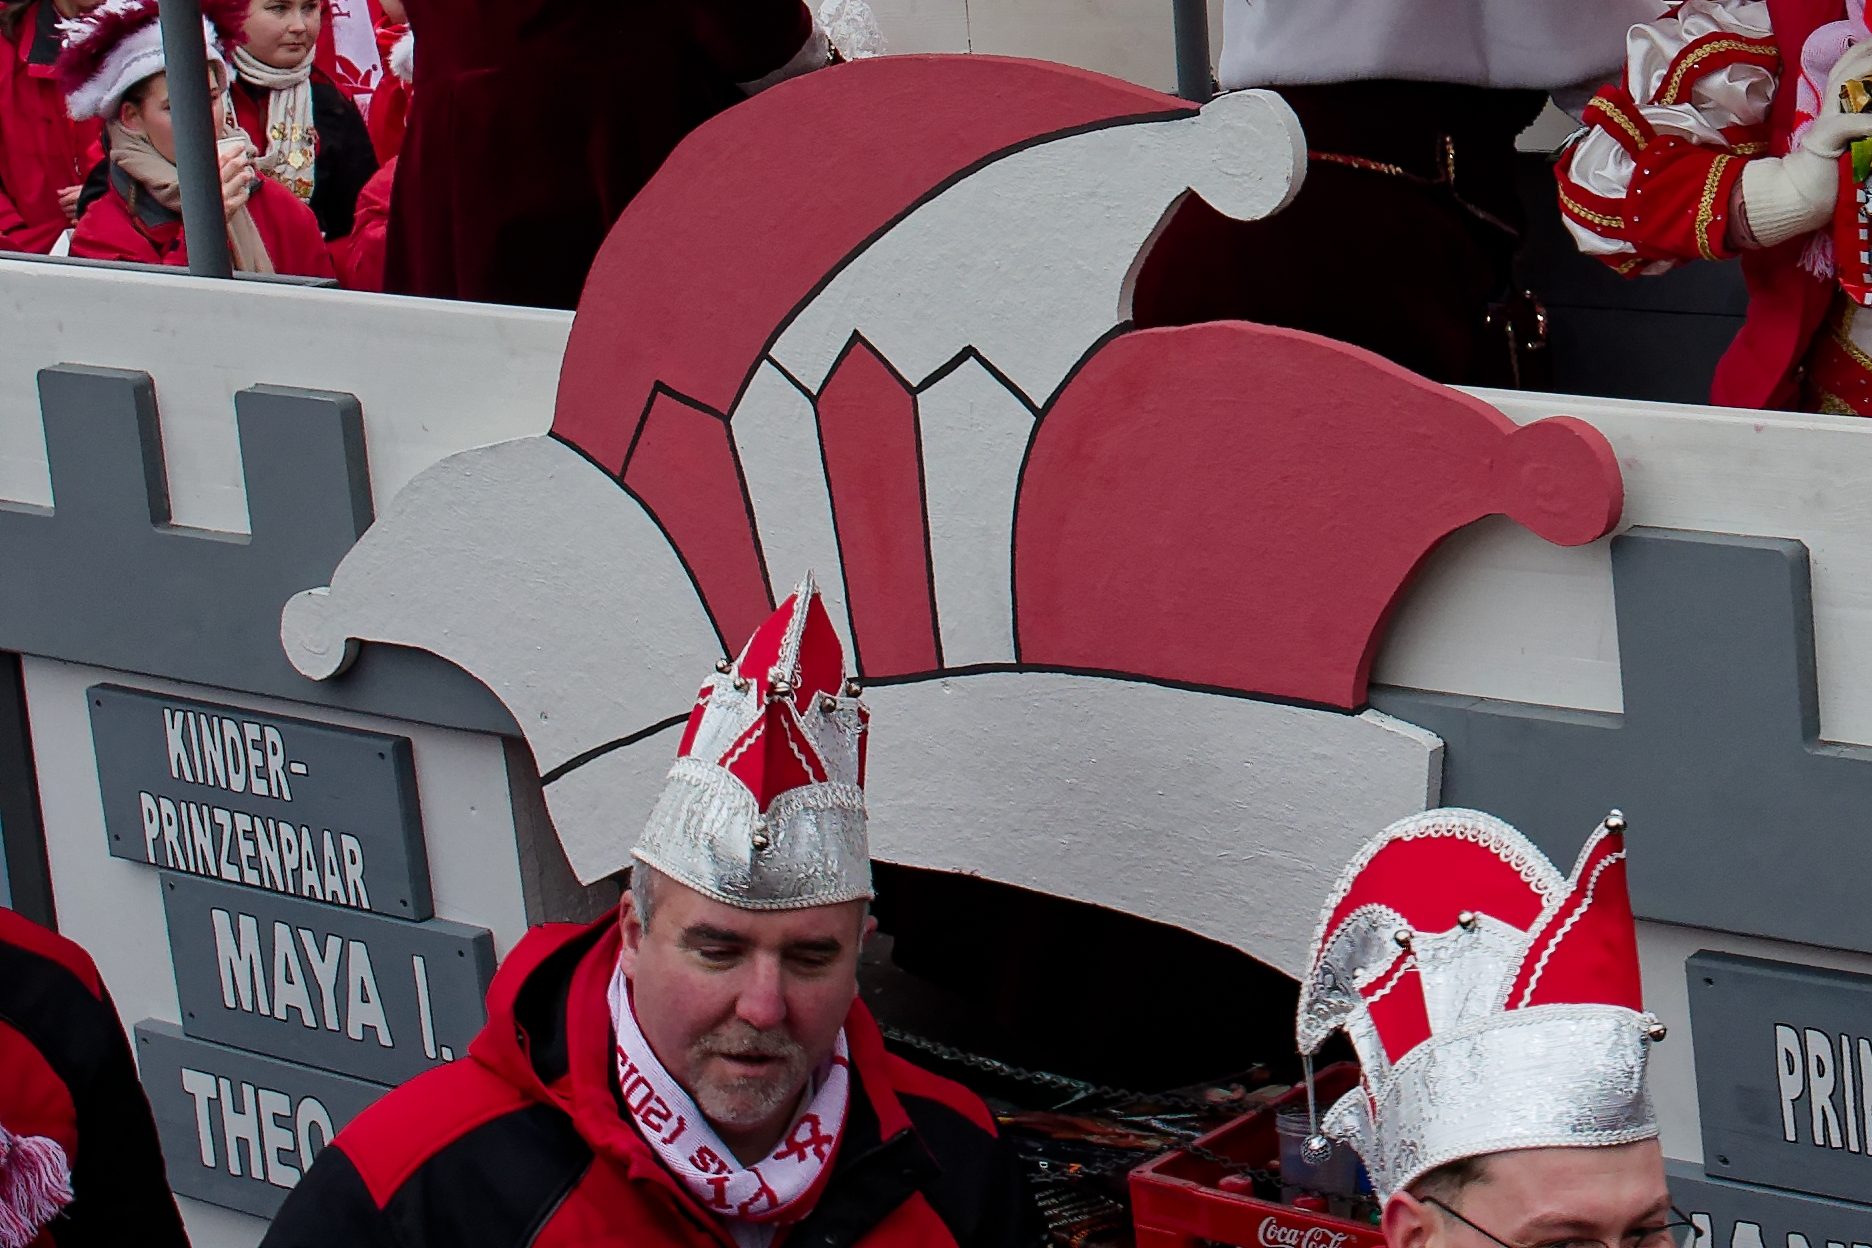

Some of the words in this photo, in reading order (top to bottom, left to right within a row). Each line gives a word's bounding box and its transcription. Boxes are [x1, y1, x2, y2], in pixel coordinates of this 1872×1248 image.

[163, 708, 310, 802] KINDER-
[139, 791, 372, 911] PRINZENPAAR
[210, 908, 394, 1050] MAYA
